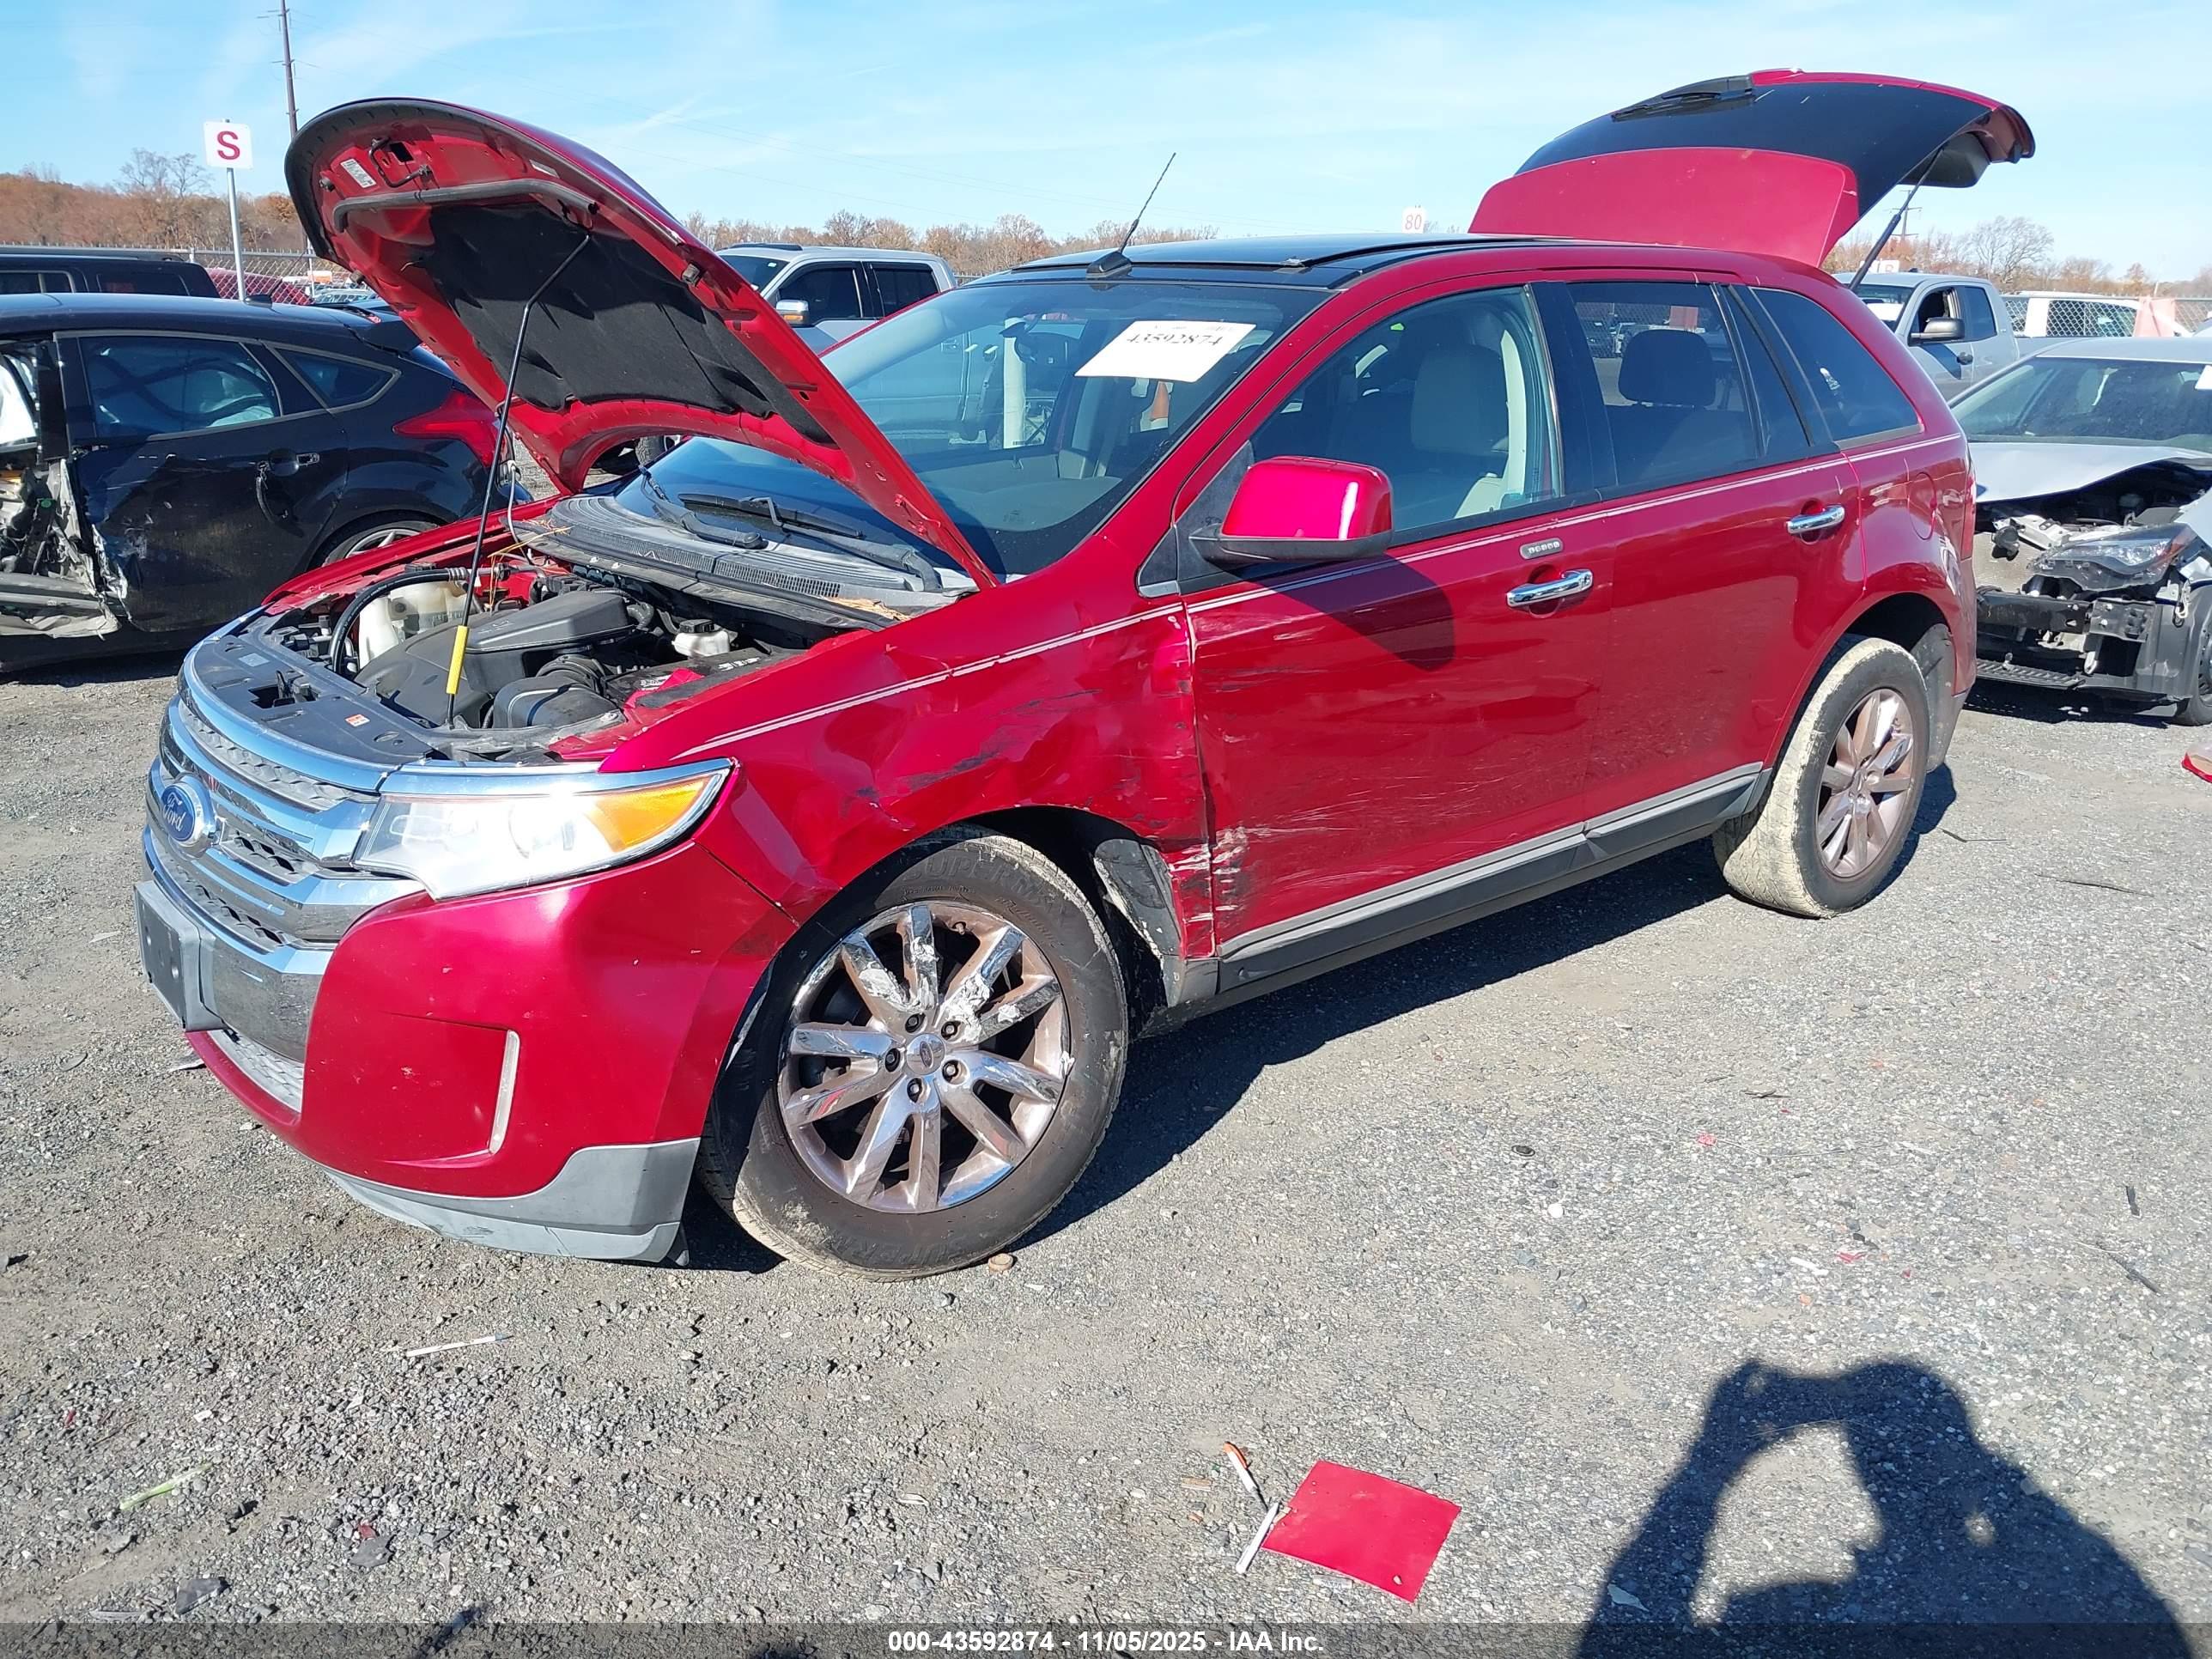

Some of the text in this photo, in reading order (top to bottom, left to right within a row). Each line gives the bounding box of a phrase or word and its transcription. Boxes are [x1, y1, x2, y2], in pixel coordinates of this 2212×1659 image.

[217, 131, 240, 160] S
[1405, 215, 1421, 230] 80
[163, 792, 186, 831] Ford
